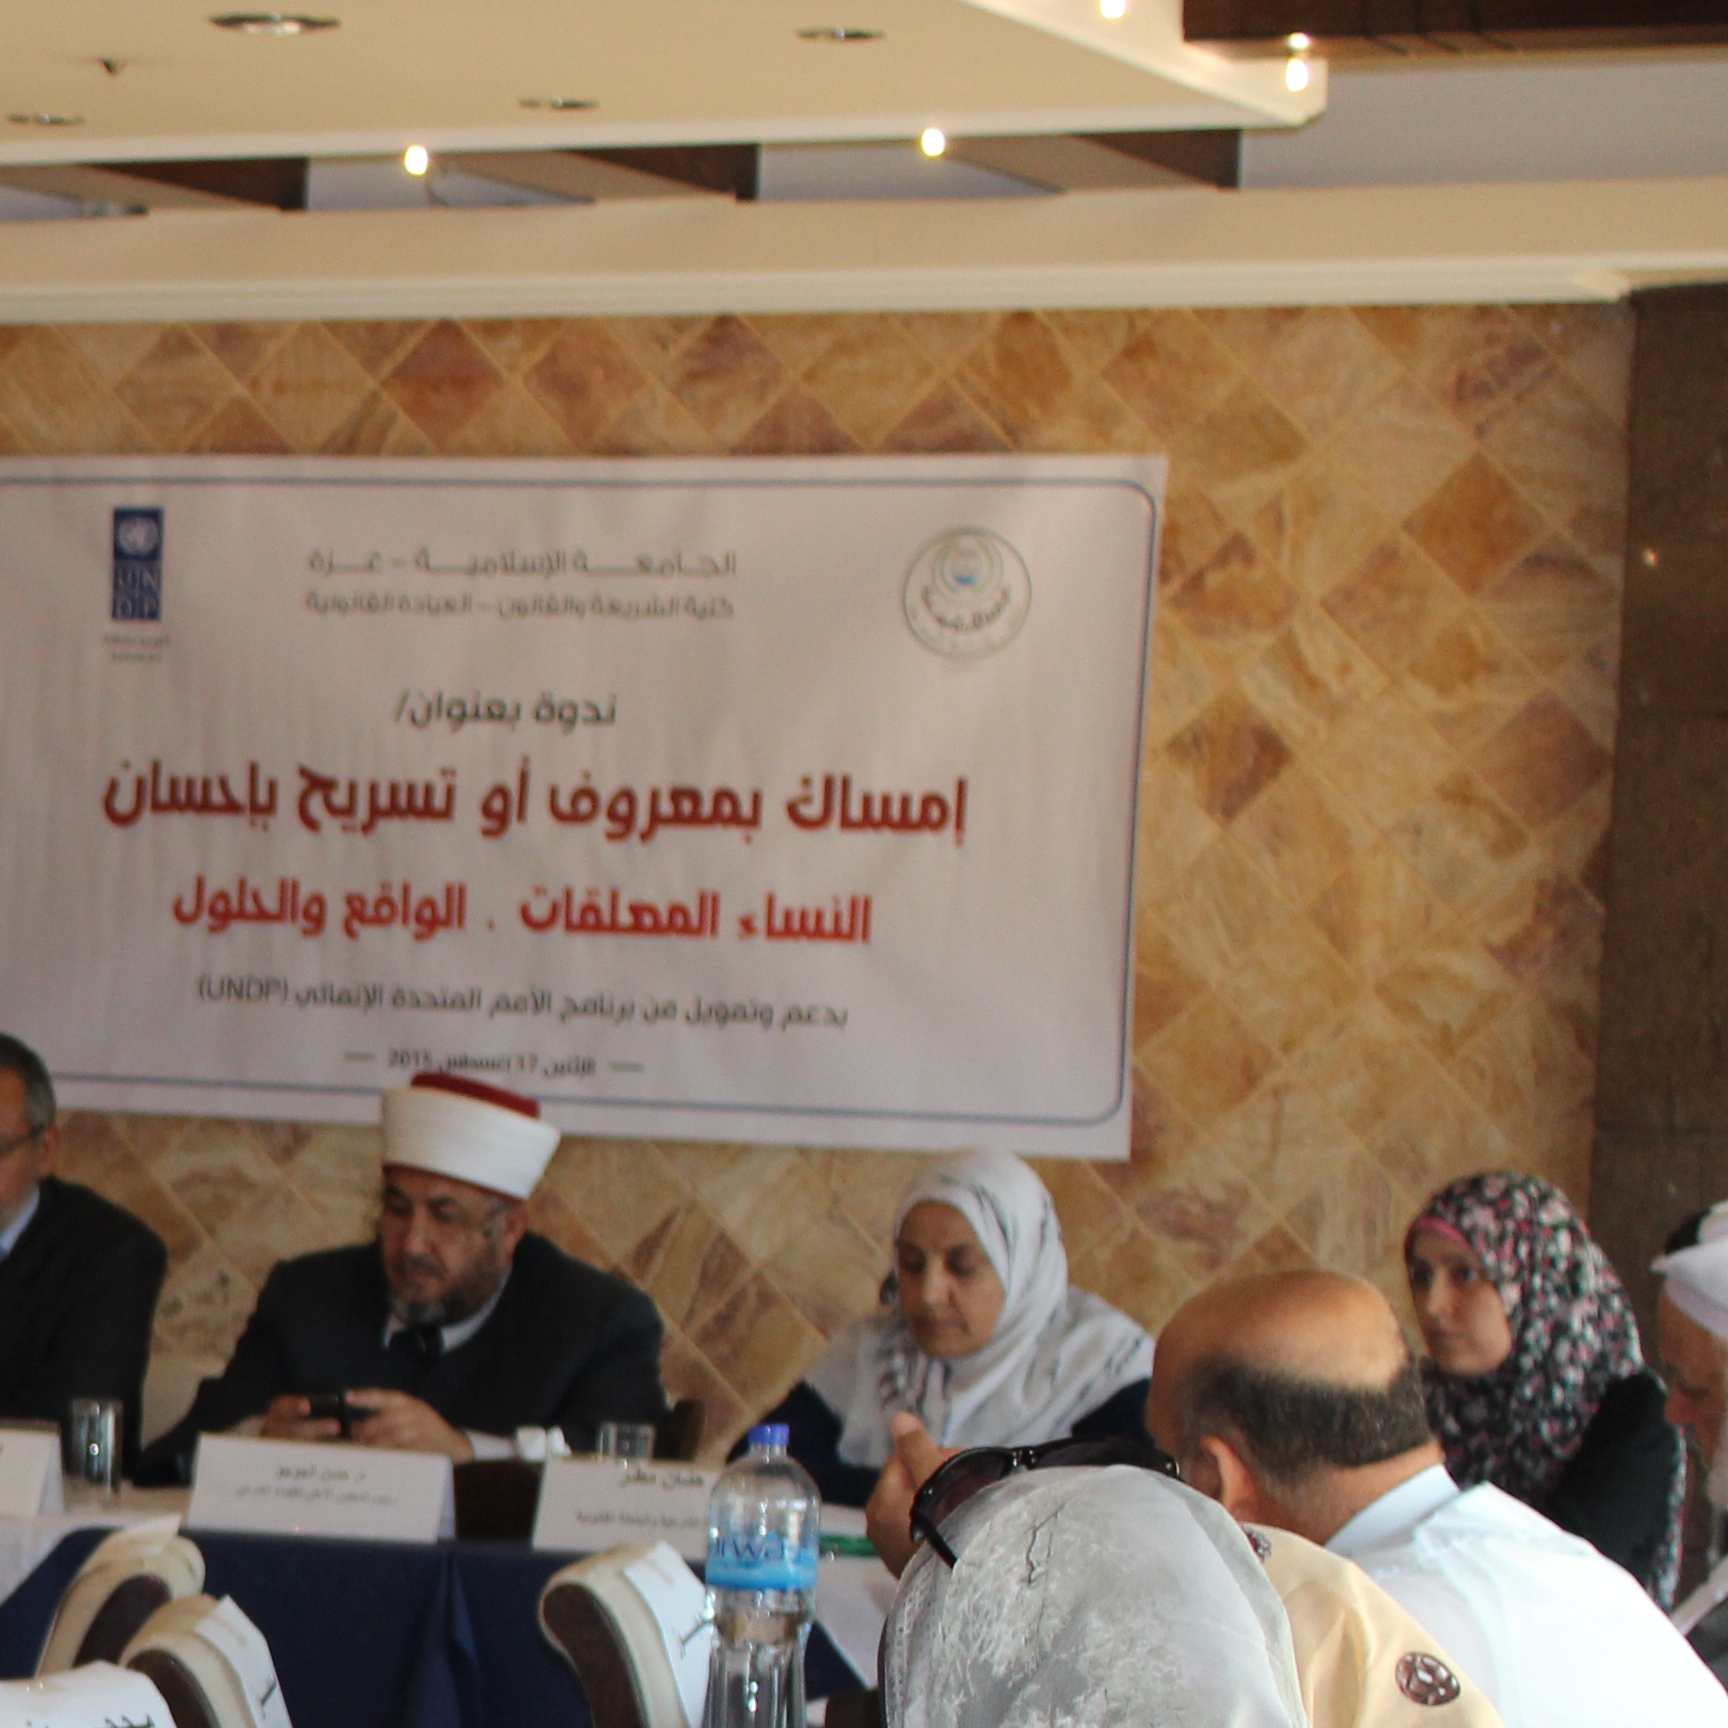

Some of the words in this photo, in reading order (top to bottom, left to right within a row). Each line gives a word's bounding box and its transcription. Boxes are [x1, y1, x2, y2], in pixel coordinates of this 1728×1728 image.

[533, 692, 618, 735] ندوة
[103, 758, 279, 832] بإحسان
[296, 763, 458, 837] تسريح
[480, 753, 532, 839] أو
[548, 769, 762, 846] بمعروف
[786, 771, 967, 848] إمساك
[171, 872, 328, 943] والحلول
[341, 880, 467, 942] الواقع
[518, 884, 723, 941] المعلقات
[736, 888, 873, 944] النساء
[196, 973, 291, 1007] (UNDP)
